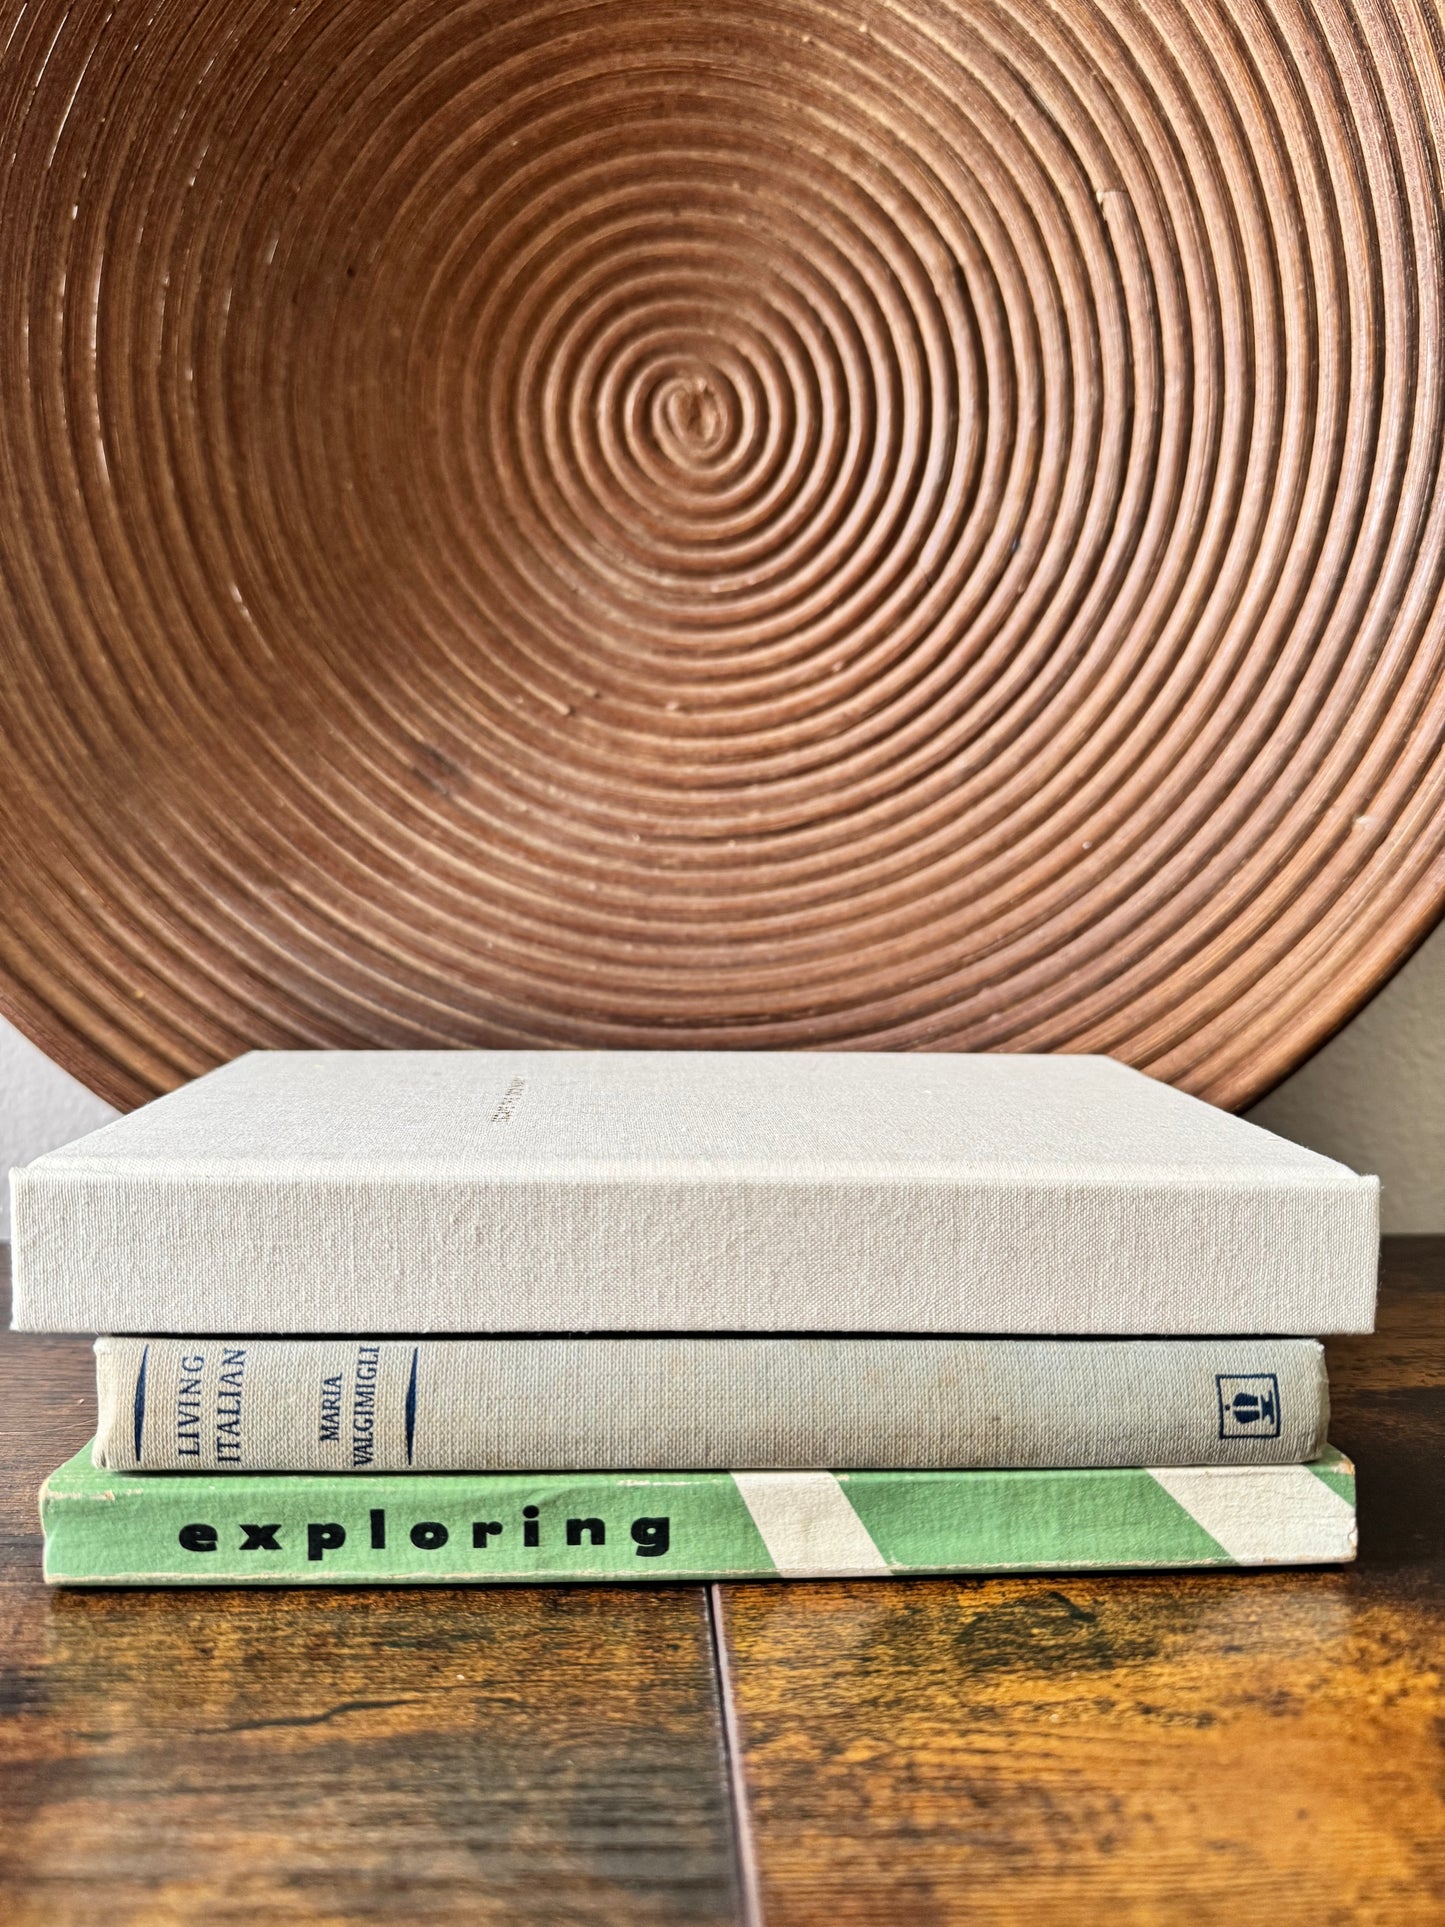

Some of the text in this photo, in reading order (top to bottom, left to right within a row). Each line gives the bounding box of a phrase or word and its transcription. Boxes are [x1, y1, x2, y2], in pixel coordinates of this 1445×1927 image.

[177, 1354, 205, 1457] LIVING
[217, 1348, 247, 1463] ITALIAN
[320, 1372, 343, 1443] MARIA
[353, 1346, 380, 1467] VALGIMIGLI
[178, 1504, 670, 1561] exploring
